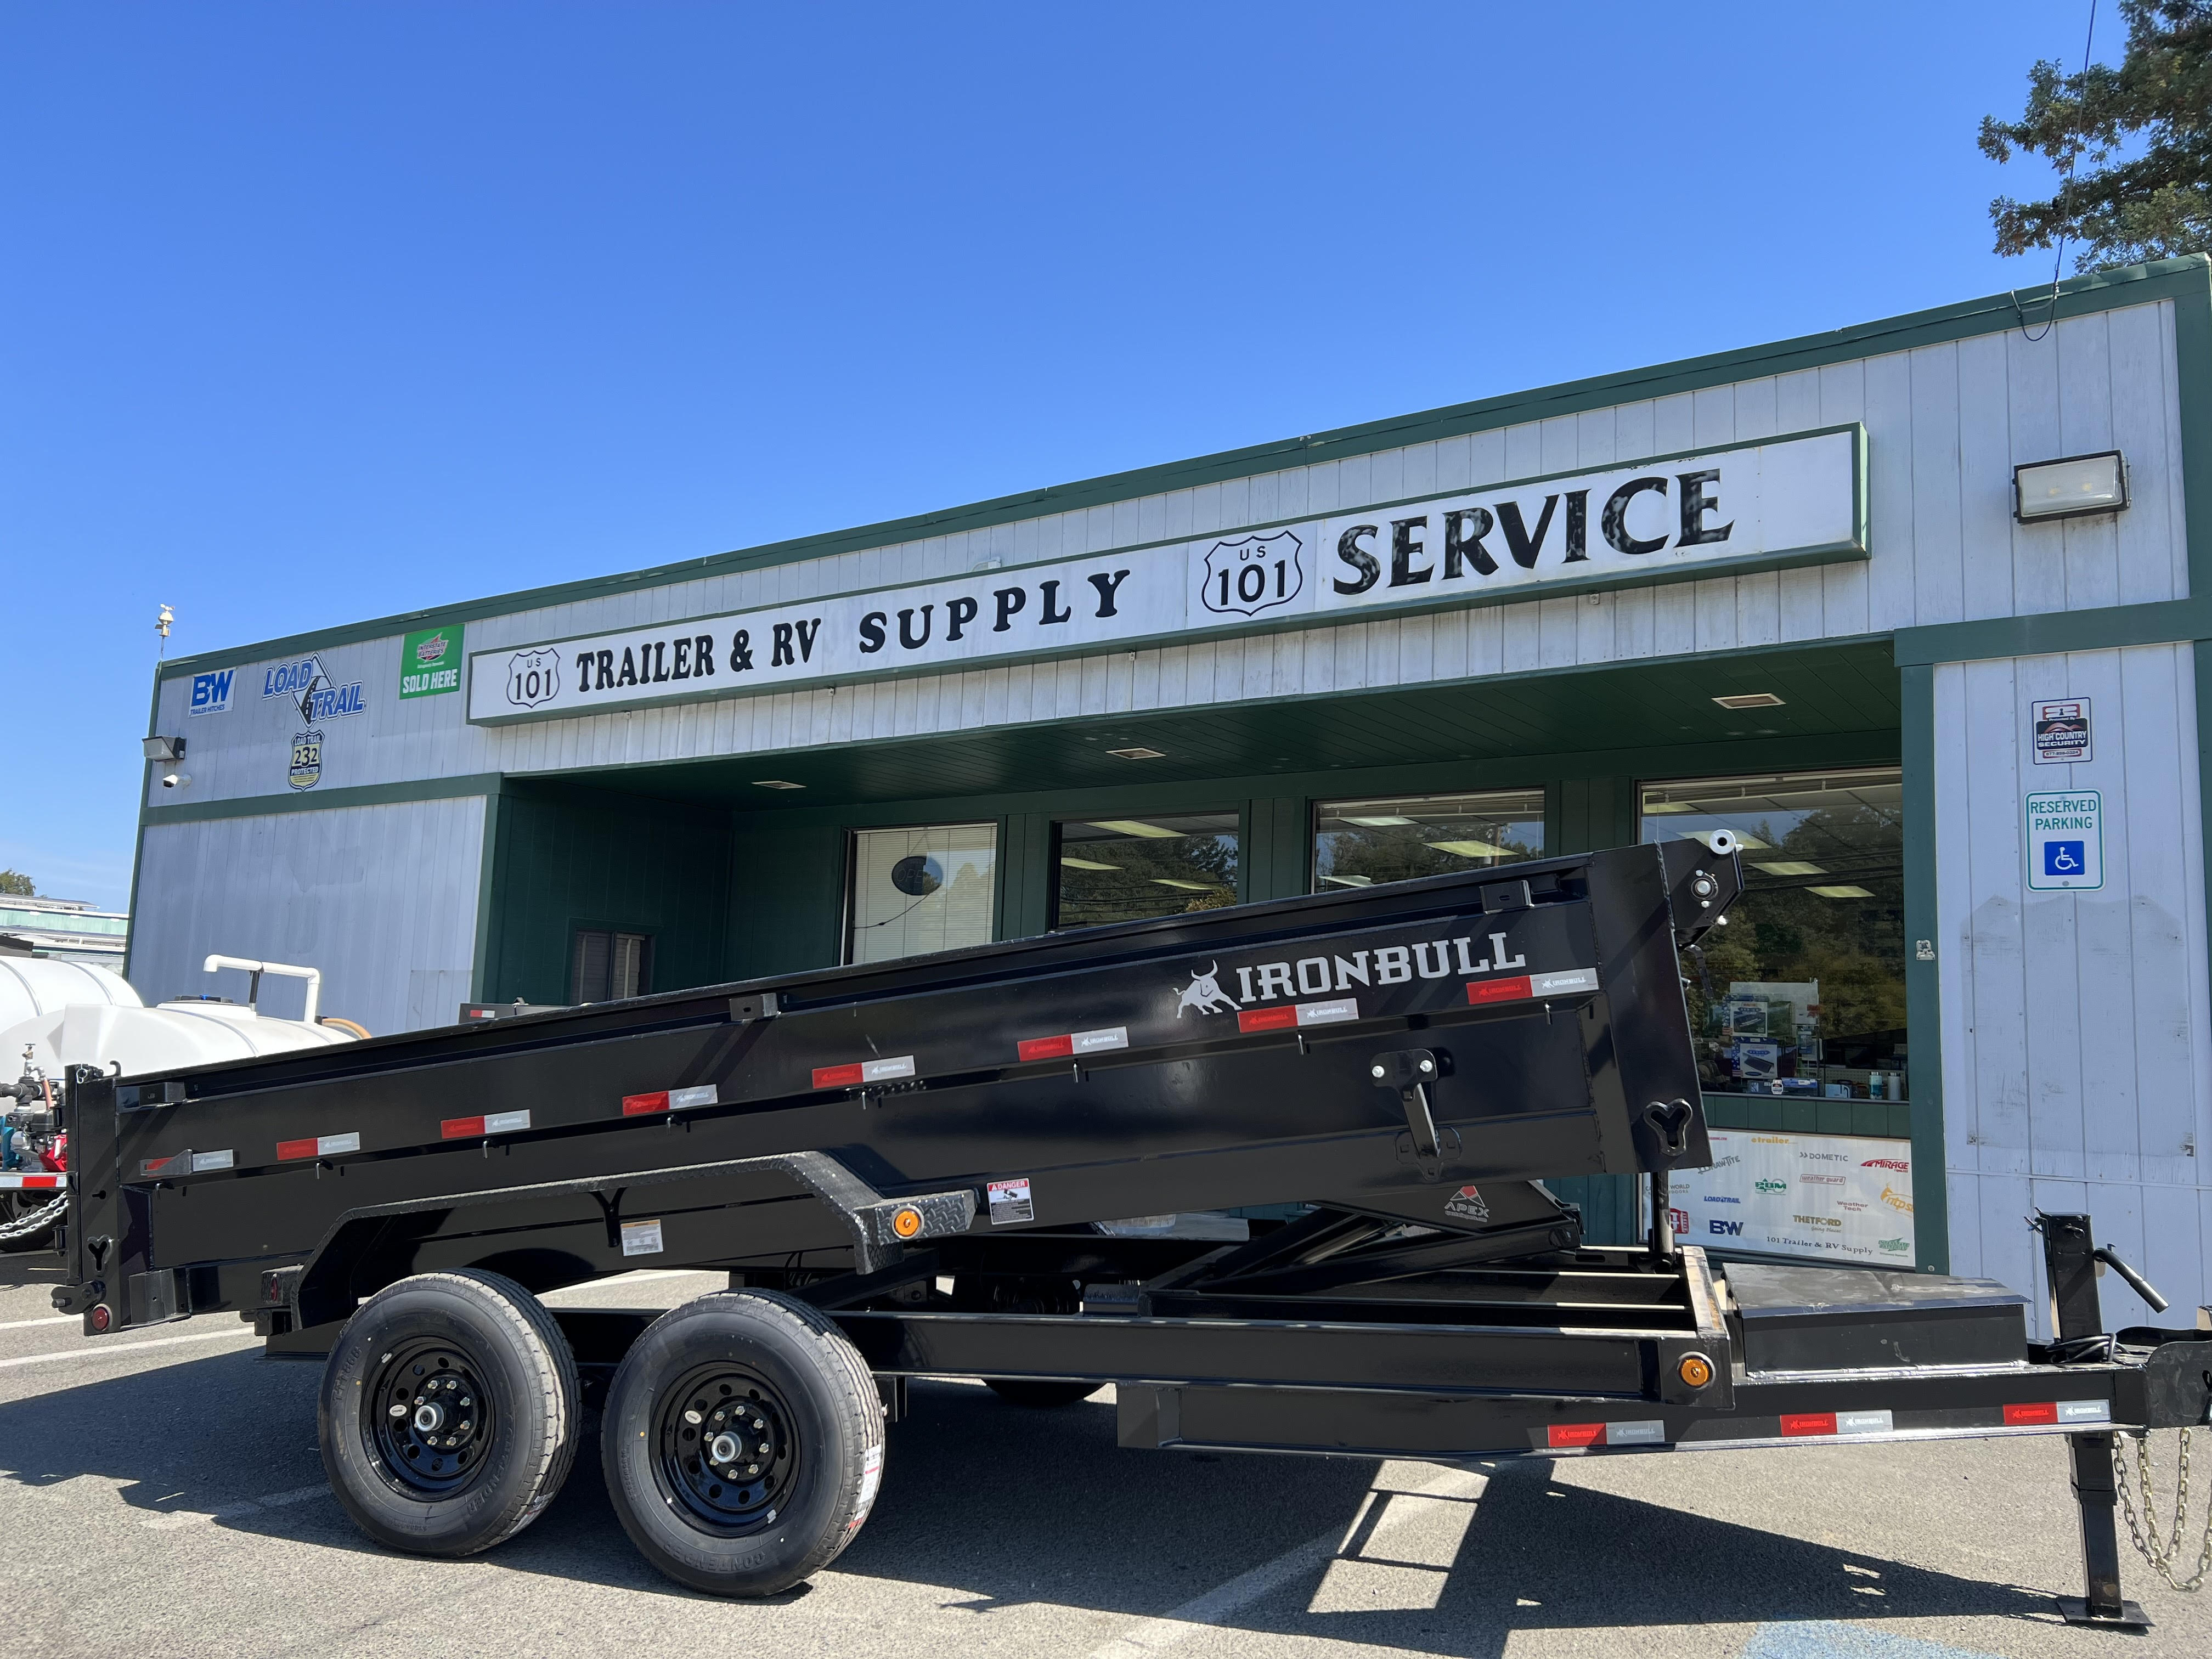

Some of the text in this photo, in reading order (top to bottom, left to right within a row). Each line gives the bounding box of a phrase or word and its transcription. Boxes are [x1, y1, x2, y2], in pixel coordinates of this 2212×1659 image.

[1333, 468, 1736, 595] SERVICE
[1219, 559, 1287, 606] 101
[859, 569, 1130, 654] SUPPLY
[418, 641, 447, 651] INTERSTATE
[418, 648, 444, 657] BATTERIES
[576, 618, 821, 692] TRAILER & RV
[263, 660, 313, 698] LOAD
[403, 668, 458, 693] SOLD HERE
[515, 668, 552, 700] 101
[310, 681, 365, 720] TRAIL
[190, 704, 225, 715] TRAILER HITCHES
[295, 735, 321, 746] LOAD TRAIL
[2038, 730, 2087, 742] HIGH COUNTRY
[2038, 739, 2086, 747] SECURITY
[295, 746, 318, 766] 232
[291, 766, 319, 776] PROTECTED
[2030, 799, 2097, 814] RESERVED
[2035, 816, 2093, 831] PARKING
[1235, 932, 1527, 1003] IRONBULL
[1552, 975, 1587, 986] IRONBULL
[1317, 1006, 1348, 1015] IRONBULL
[1751, 1136, 1790, 1144] etrailer
[1809, 1153, 1849, 1161] DOMETIC
[1874, 1159, 1910, 1170] MIRAGE
[997, 1181, 1025, 1190] DANGER
[1444, 1201, 1489, 1218] APEX
[1792, 1215, 1842, 1227] THETFORD
[1782, 1237, 1813, 1248] Trailer
[1841, 1244, 1873, 1256] Supply
